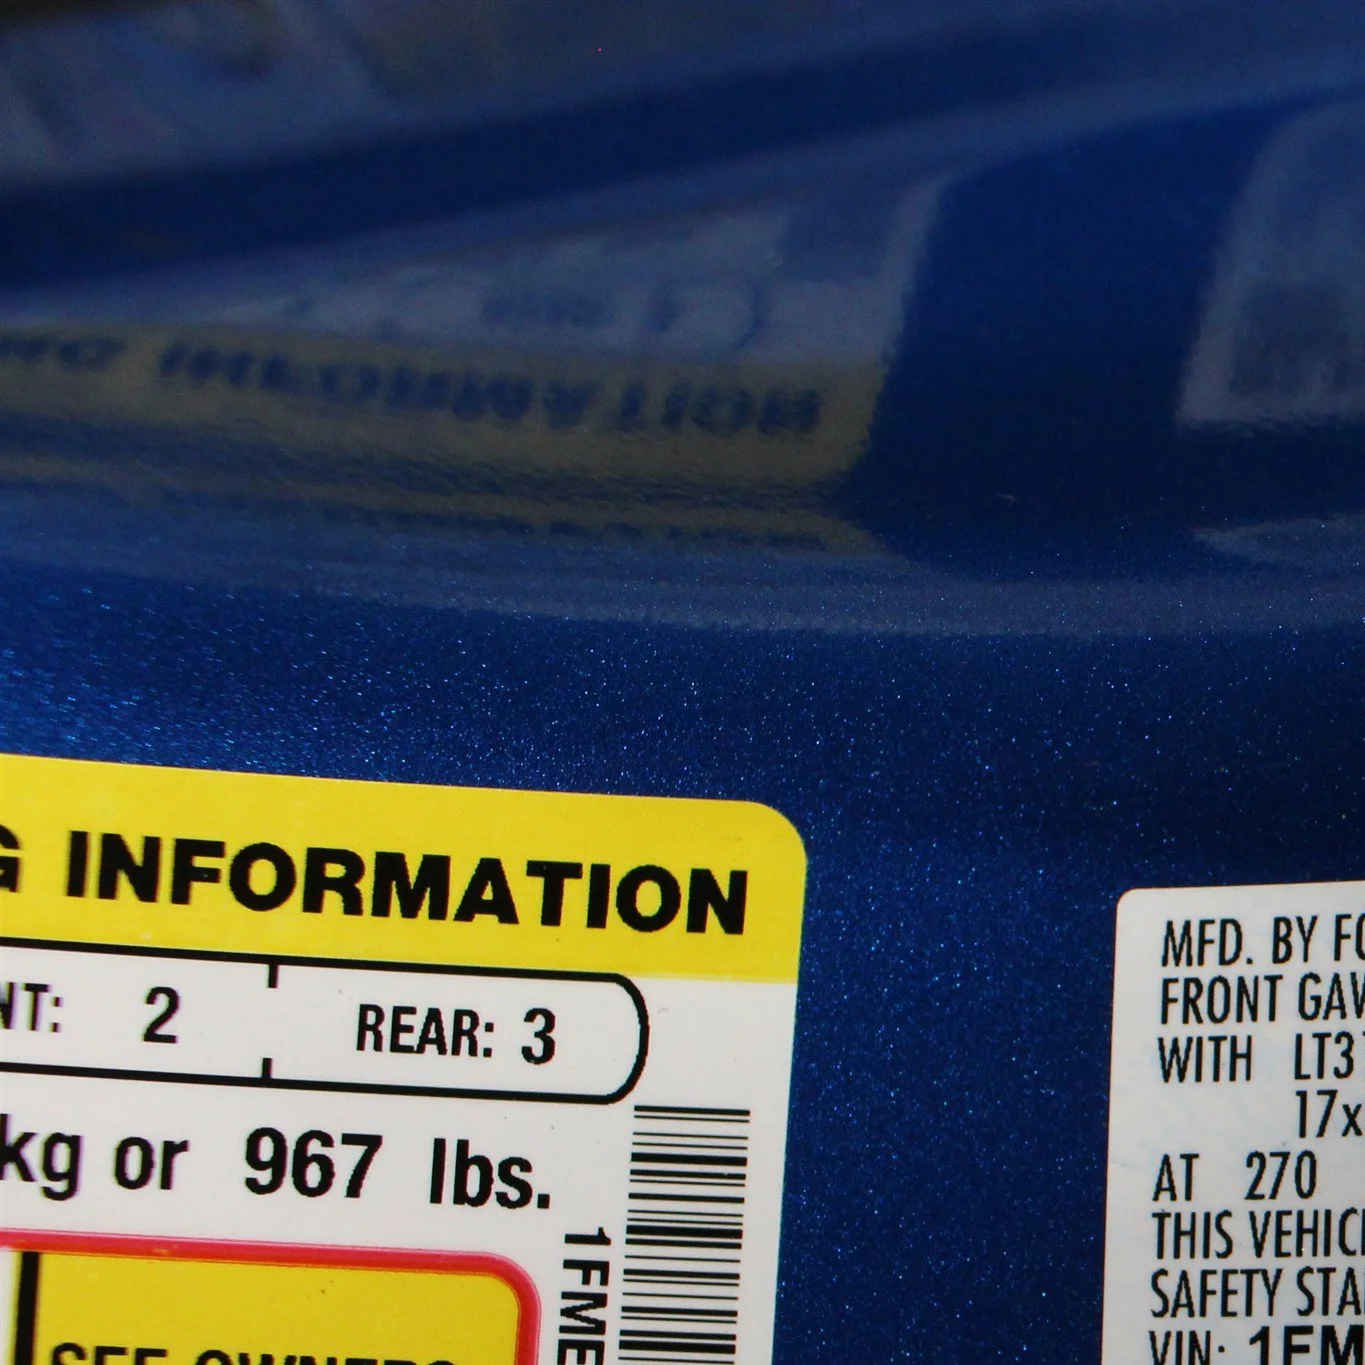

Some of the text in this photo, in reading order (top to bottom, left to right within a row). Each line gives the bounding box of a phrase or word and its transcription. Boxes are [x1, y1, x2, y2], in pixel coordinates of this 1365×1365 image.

[66, 830, 747, 935] INFORMATION
[1162, 919, 1253, 967] MFD.
[1272, 916, 1317, 964] BY
[143, 987, 179, 1043] 2
[1161, 975, 1283, 1025] FRONT
[357, 1004, 555, 1065] REAR: 3
[1158, 1035, 1252, 1083] WITH
[114, 1137, 188, 1190] or
[245, 1127, 382, 1198] 967
[430, 1138, 550, 1209] lbs.
[1153, 1154, 1199, 1201] AT
[1245, 1150, 1316, 1200] 270
[1152, 1210, 1233, 1259] THIS
[1152, 1268, 1282, 1318] SAFETY
